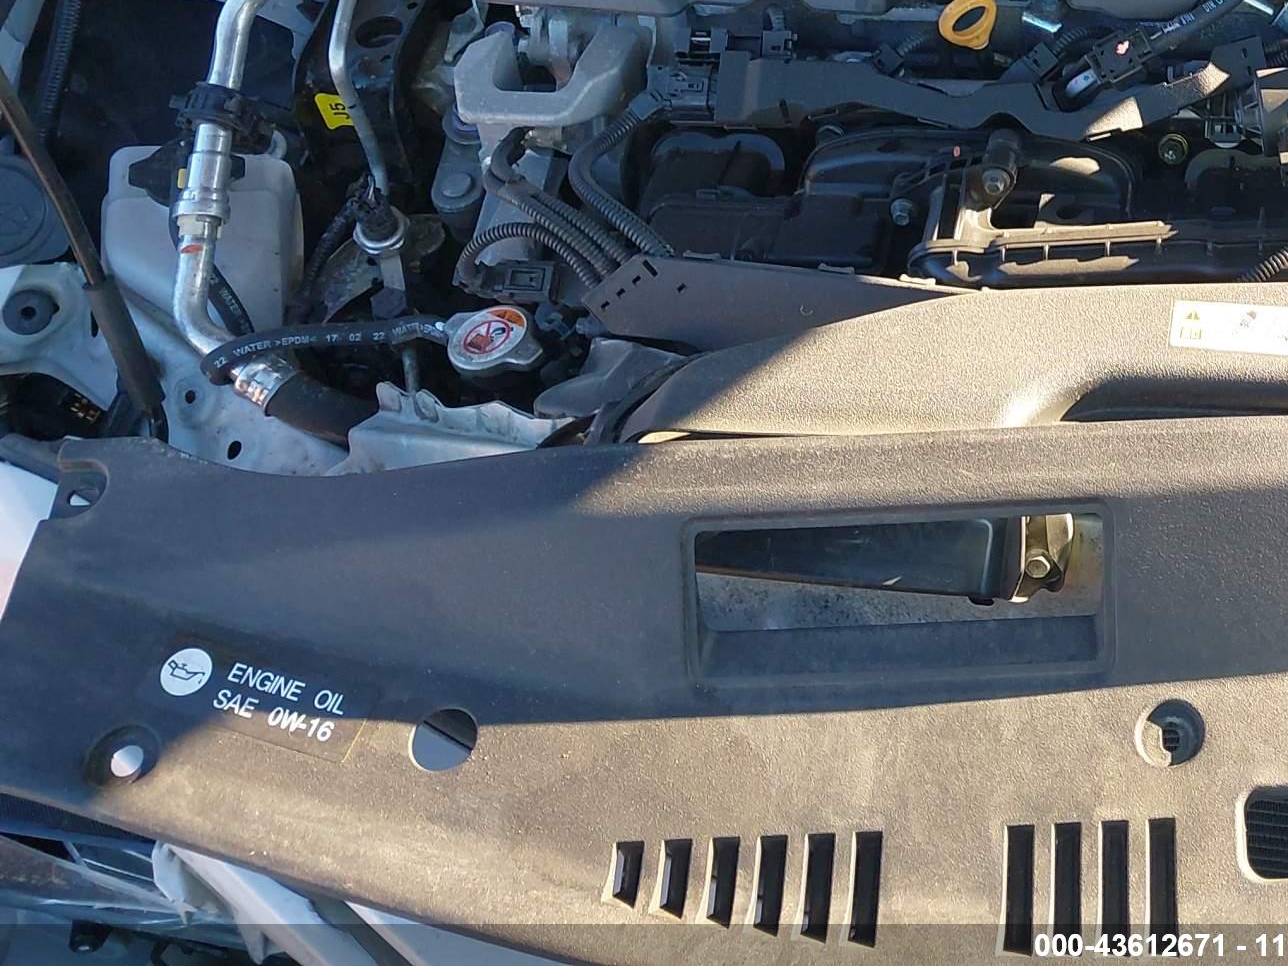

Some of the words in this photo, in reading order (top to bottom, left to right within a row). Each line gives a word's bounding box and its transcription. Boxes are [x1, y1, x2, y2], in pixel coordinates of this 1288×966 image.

[232, 339, 273, 356] WATER
[213, 689, 259, 719] SAE
[267, 705, 335, 743] 0W-16
[227, 662, 306, 701] ENGINE
[314, 689, 345, 716] OIL
